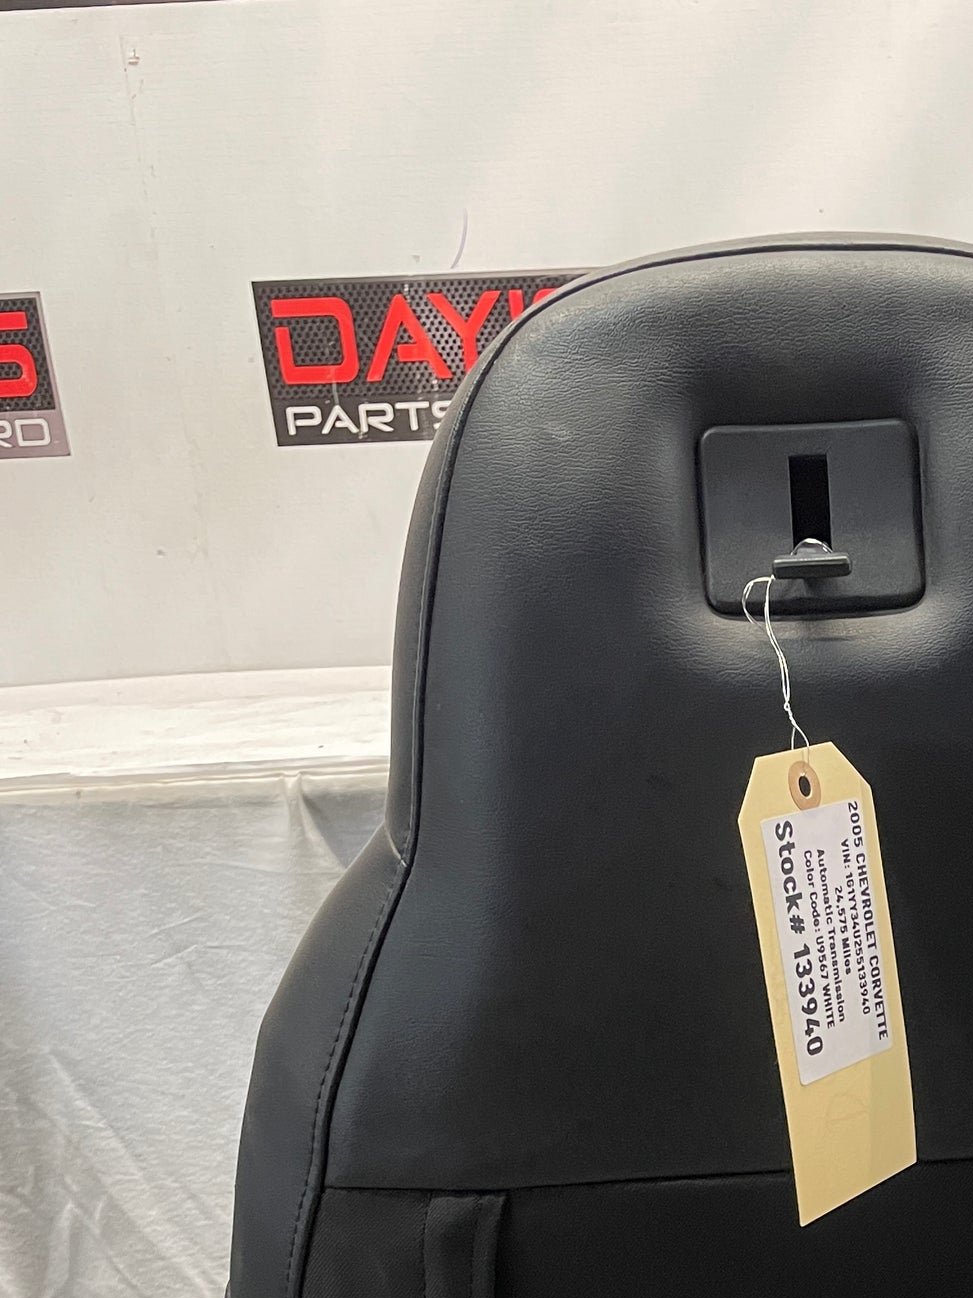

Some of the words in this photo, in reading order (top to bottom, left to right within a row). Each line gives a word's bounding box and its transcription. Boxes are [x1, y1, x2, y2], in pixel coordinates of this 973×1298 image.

[270, 288, 562, 385] DAY'
[804, 850, 815, 888] Color
[841, 838, 852, 869] VIN:
[809, 892, 821, 933] Code:
[848, 800, 864, 848] 2005
[856, 853, 877, 950] CHEVROLET
[869, 955, 889, 1041] CORVETTE
[775, 820, 806, 935] Stock#
[793, 943, 823, 1056] 133940
[816, 935, 829, 980] U9567
[817, 849, 834, 925] Automatic
[828, 926, 845, 1023] Transmission
[841, 937, 852, 975] Miles
[822, 983, 836, 1030] WHITE
